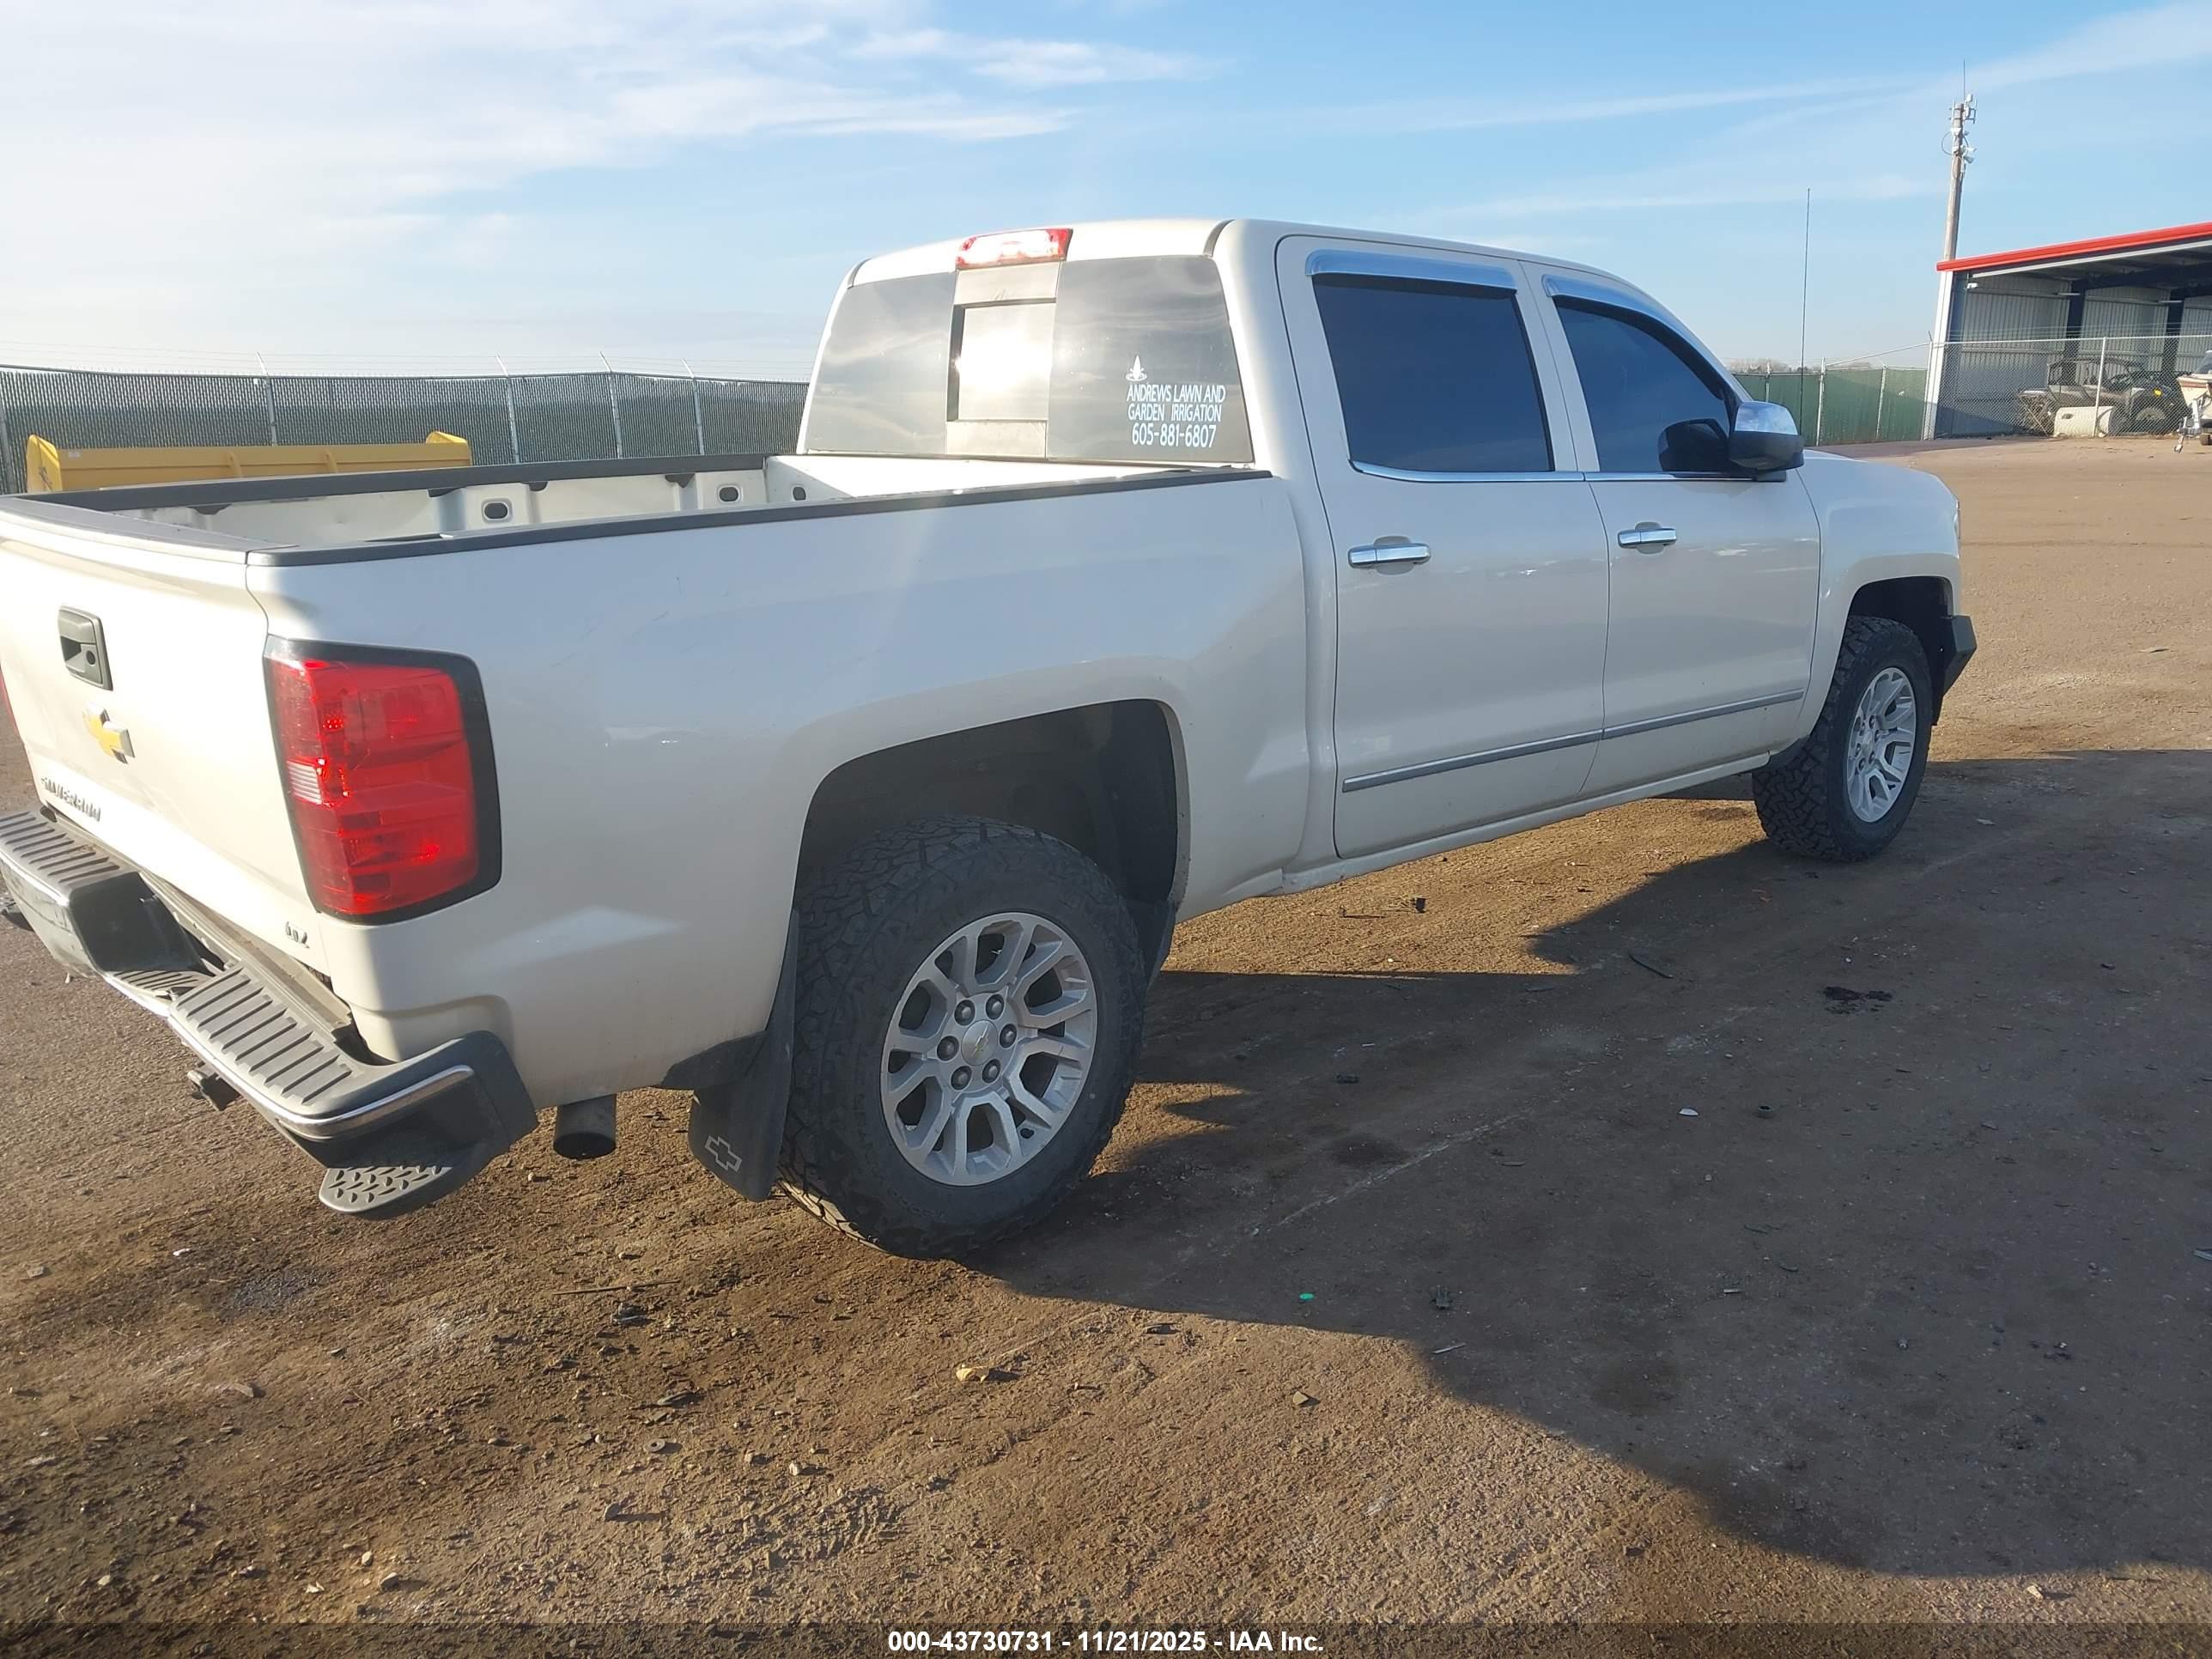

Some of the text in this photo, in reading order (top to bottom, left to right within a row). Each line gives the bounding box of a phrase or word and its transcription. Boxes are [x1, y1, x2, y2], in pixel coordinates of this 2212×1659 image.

[1127, 384, 1226, 403] ANDREWS LAWN AND
[1127, 403, 1222, 422] GARDEN IRRIGATION
[1132, 422, 1217, 447] 605-881-6807
